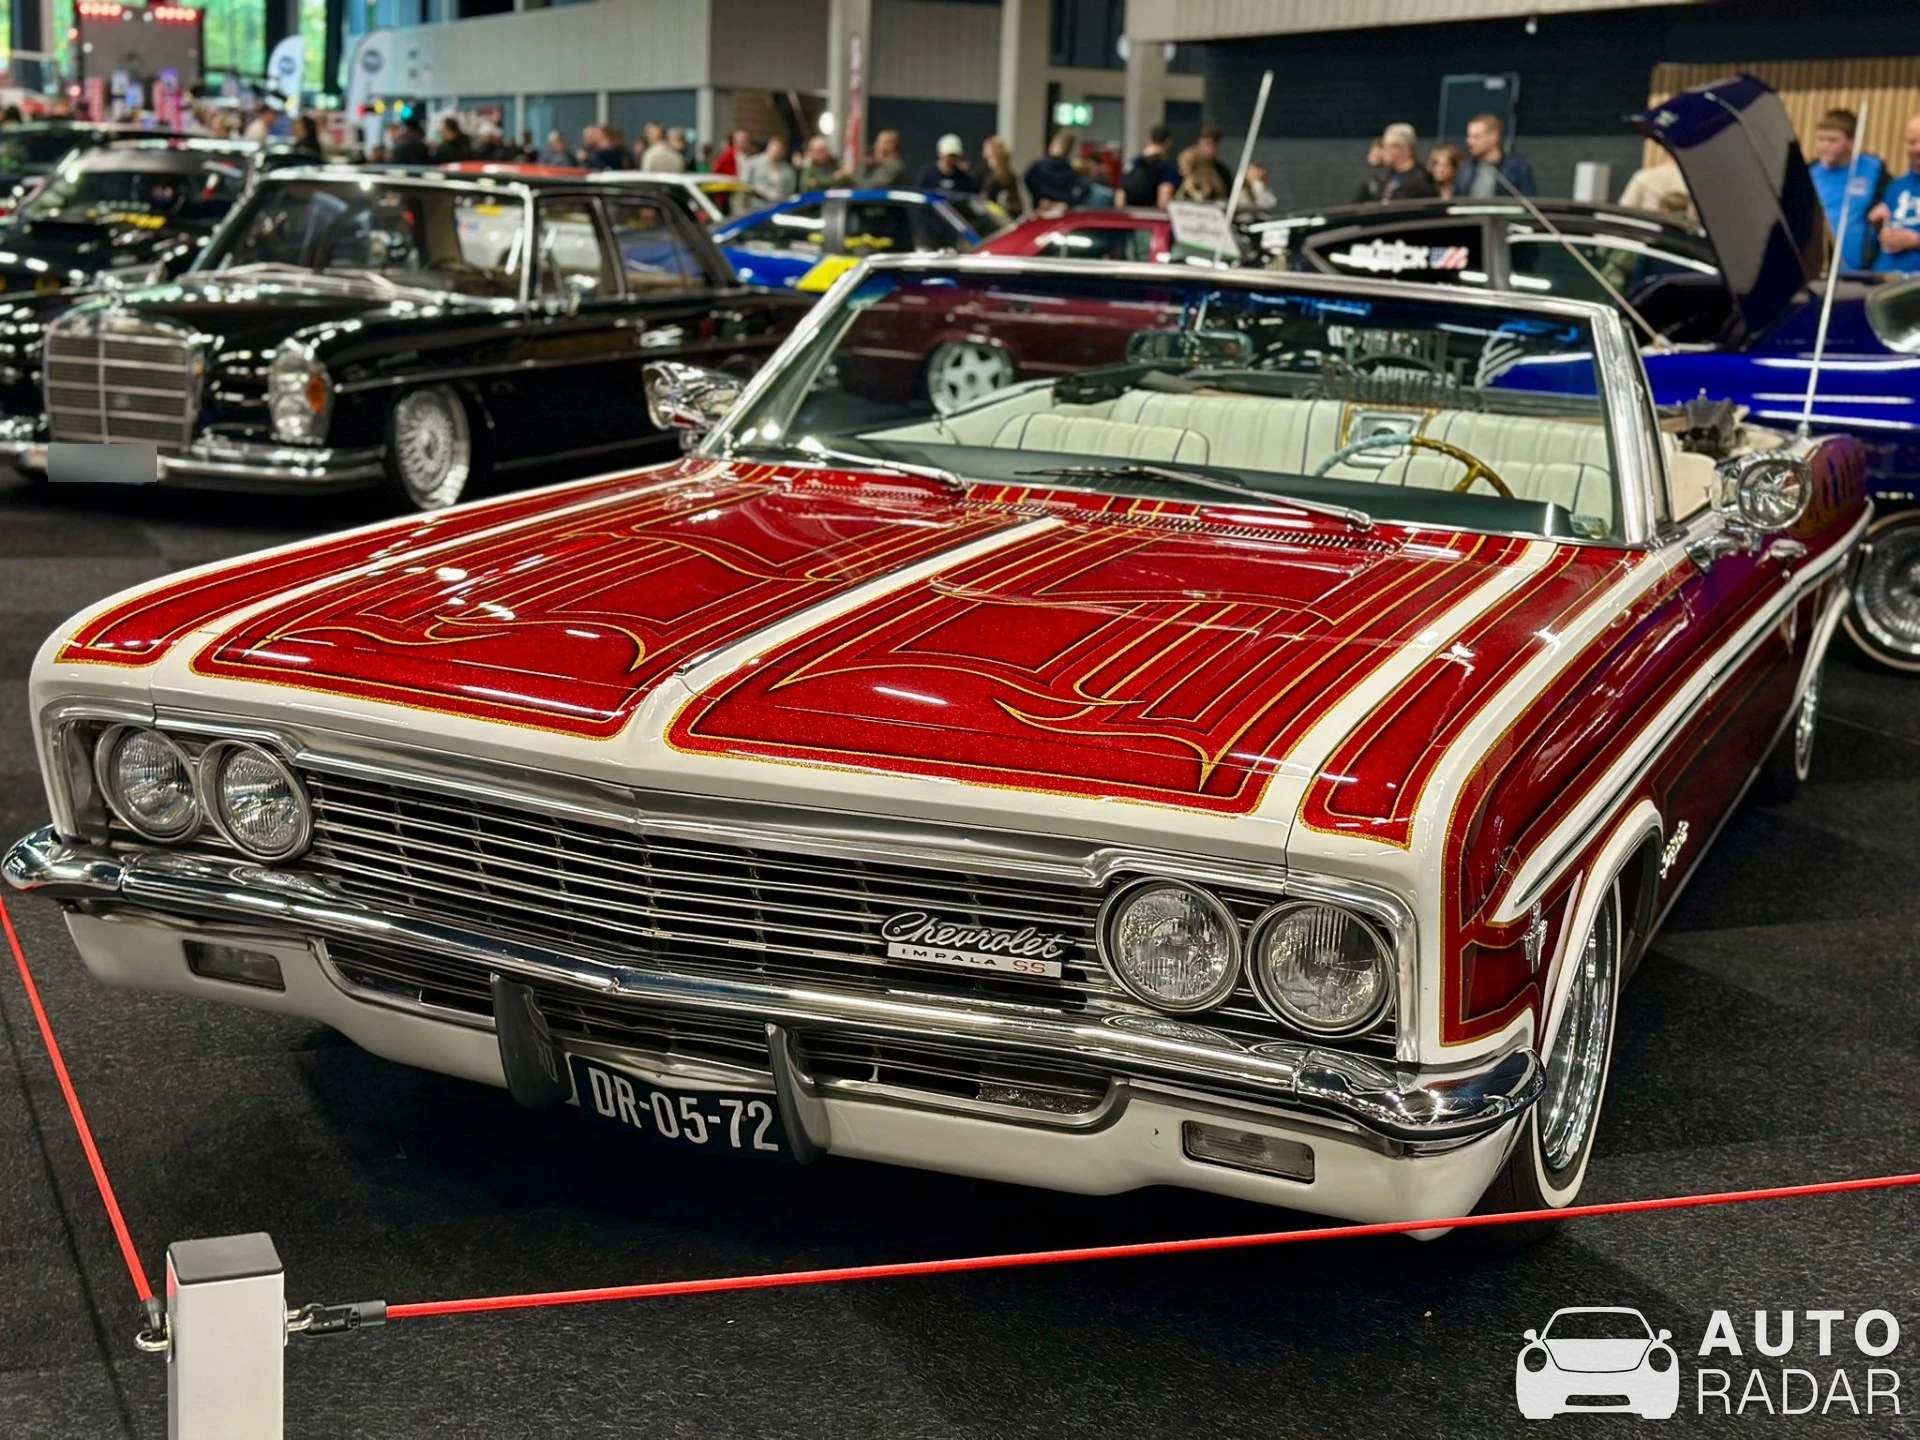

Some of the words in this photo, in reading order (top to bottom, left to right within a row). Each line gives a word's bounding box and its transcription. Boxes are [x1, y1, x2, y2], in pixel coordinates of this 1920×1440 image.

[881, 911, 1074, 958] Chevrolet
[901, 948, 997, 966] IMPALA
[1013, 959, 1046, 974] SS
[588, 1066, 779, 1151] DR-05-72
